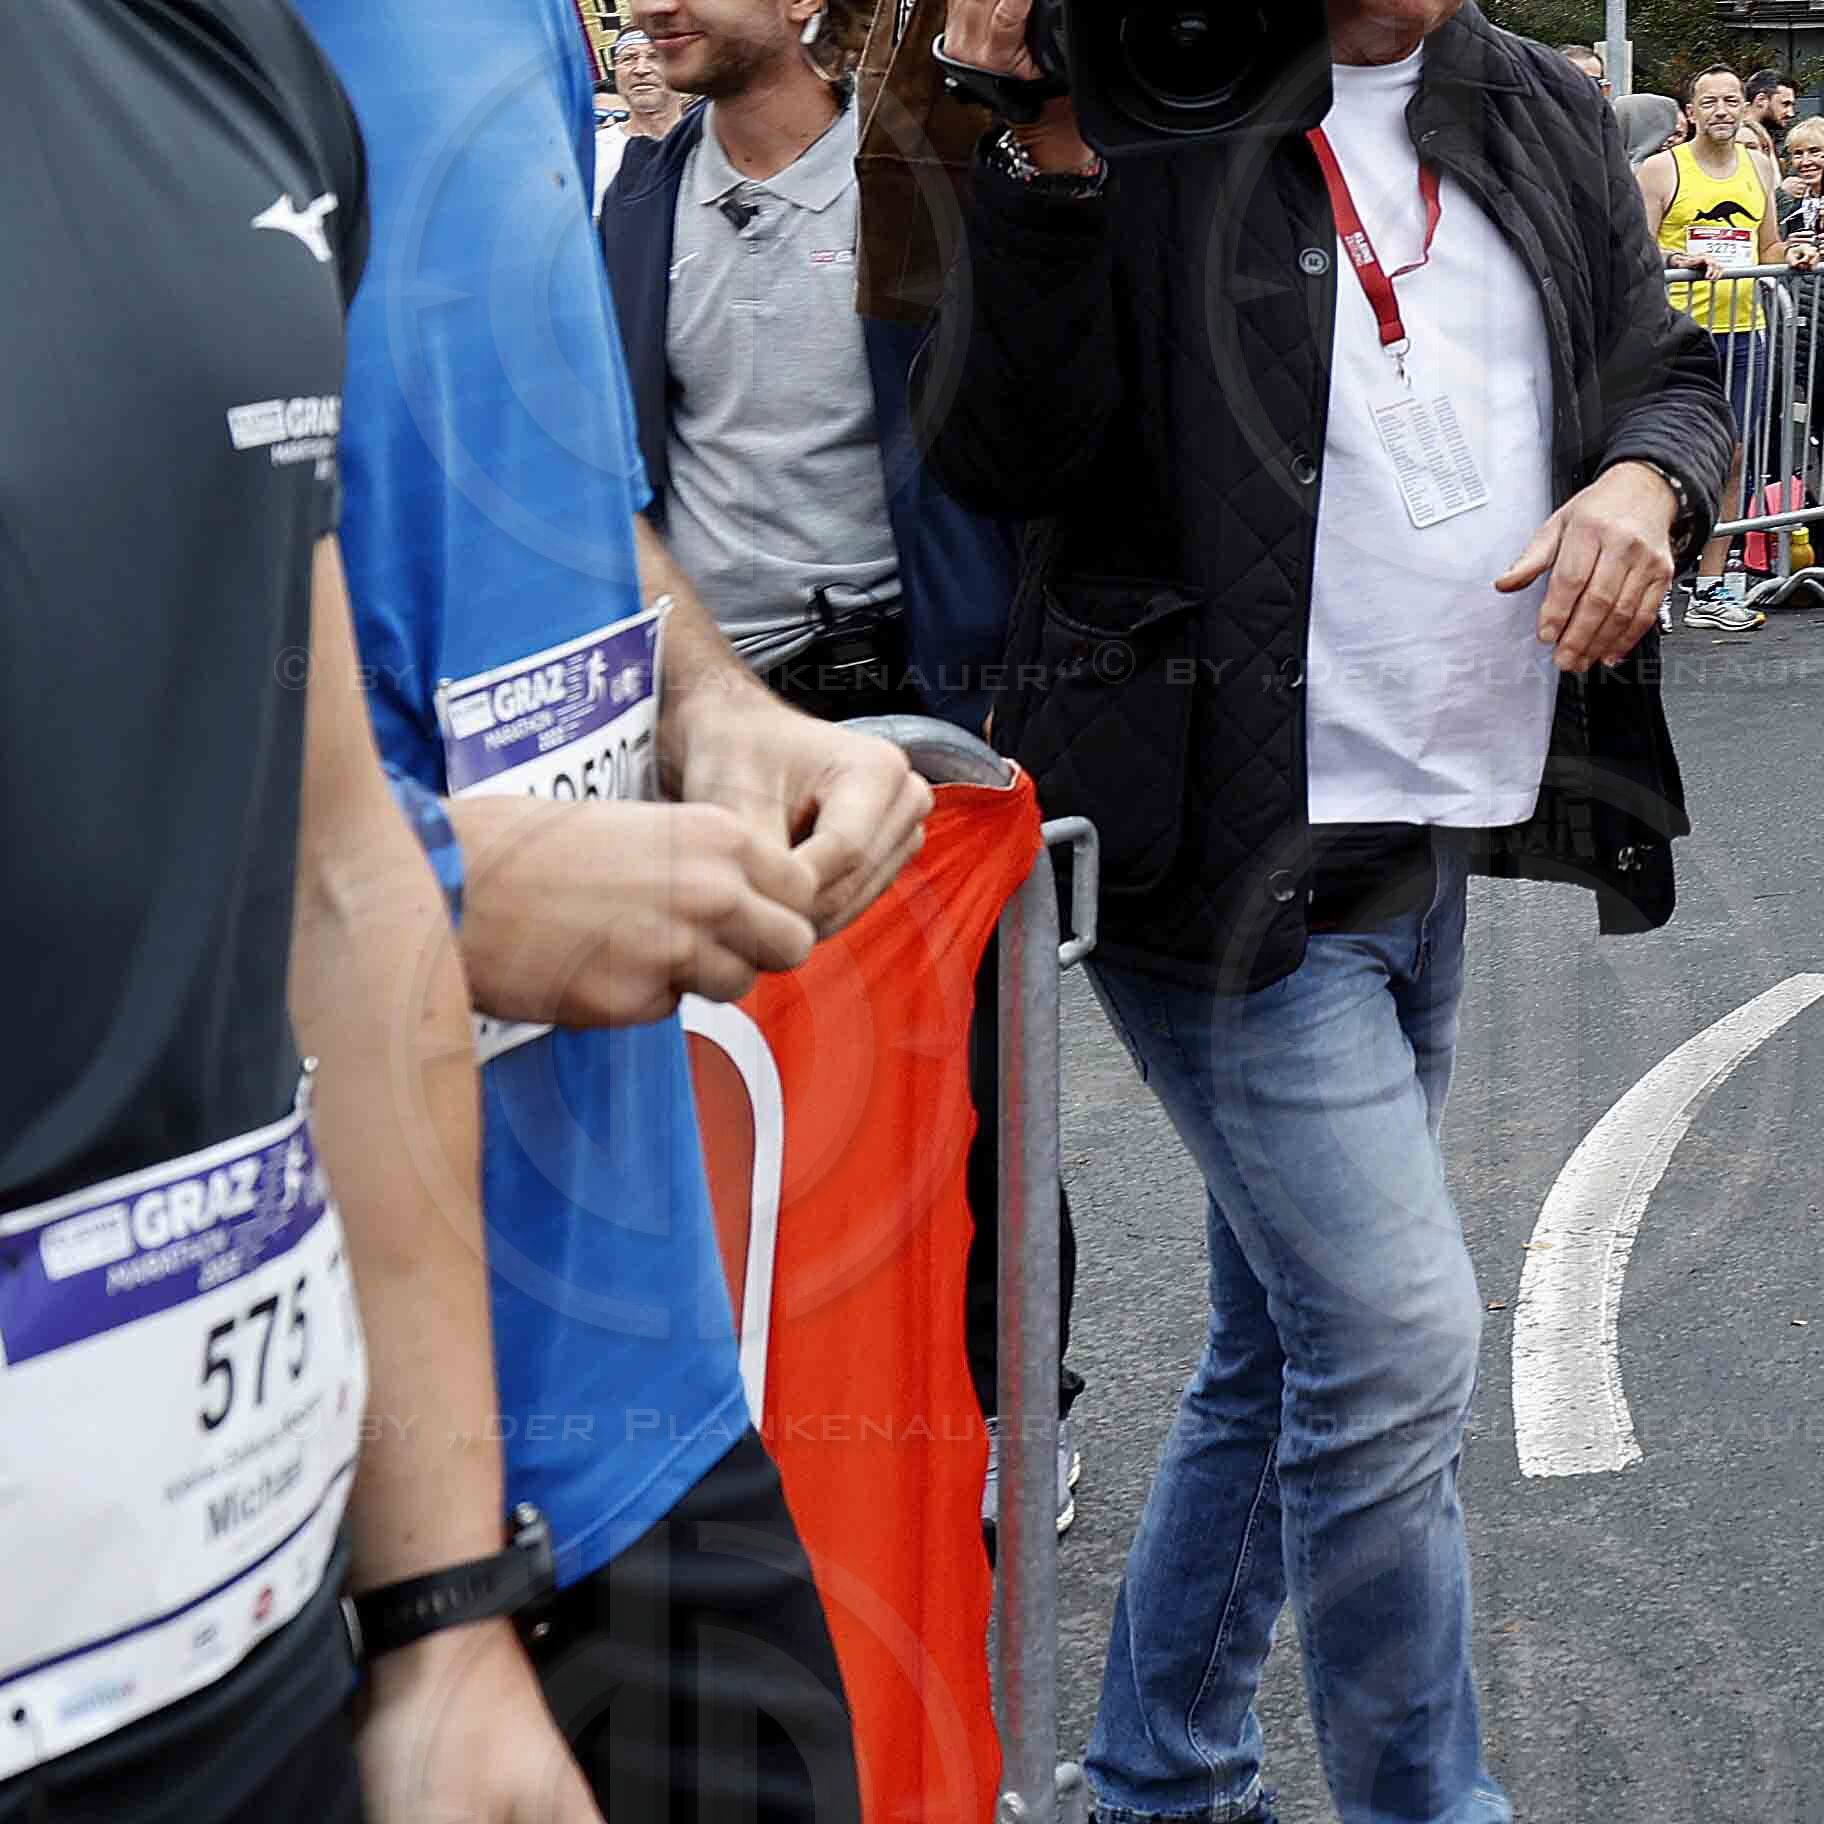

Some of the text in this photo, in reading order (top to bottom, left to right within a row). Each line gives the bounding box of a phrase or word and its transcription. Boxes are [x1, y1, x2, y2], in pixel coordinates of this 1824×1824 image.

[1704, 242, 1737, 254] 3273
[493, 661, 566, 722] GRAZ
[131, 1154, 262, 1252] GRAZ
[200, 1276, 311, 1433] 575
